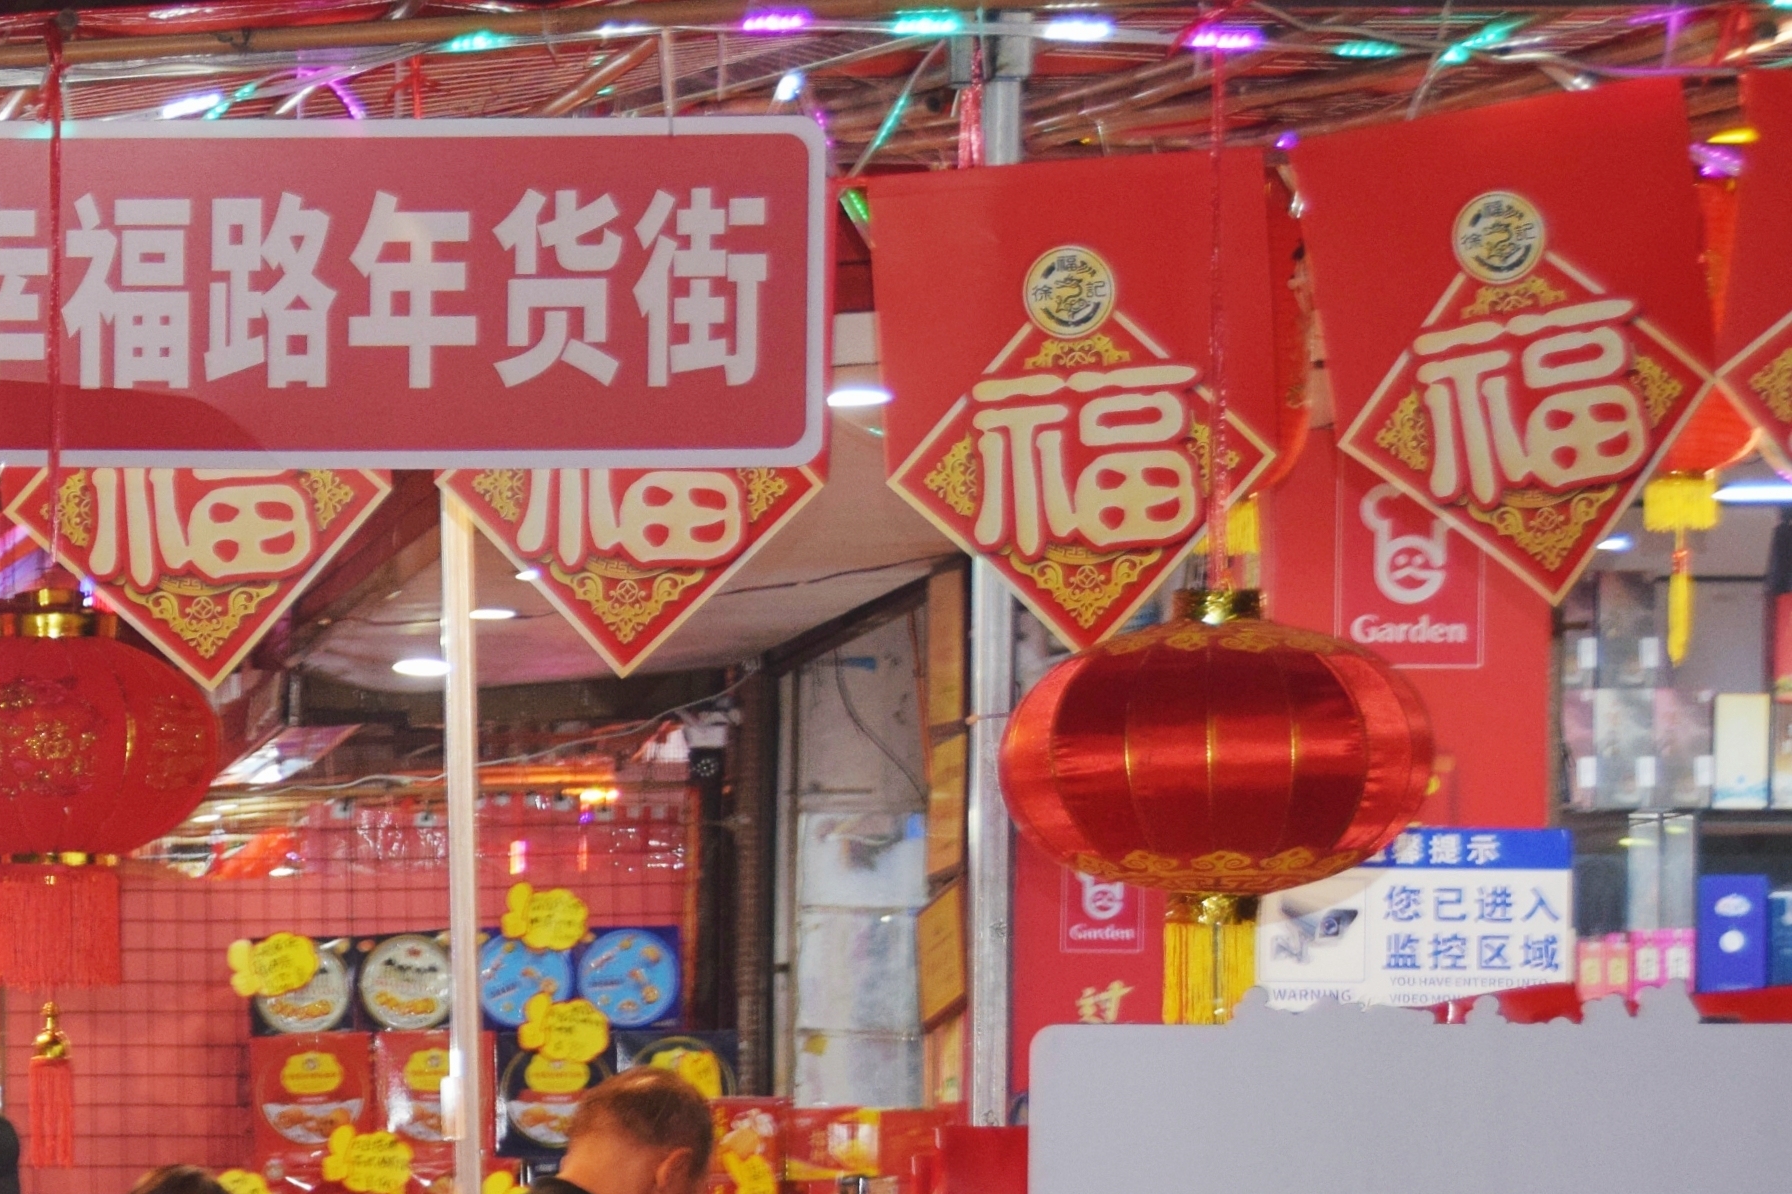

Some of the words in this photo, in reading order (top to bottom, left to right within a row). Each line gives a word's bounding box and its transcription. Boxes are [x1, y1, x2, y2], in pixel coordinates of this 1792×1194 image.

[1414, 298, 1649, 504] 福
[972, 364, 1202, 556] 福
[1350, 613, 1468, 644] Garden
[1362, 832, 1501, 866] 馨提示
[1382, 884, 1561, 923] 您已进入
[1382, 933, 1561, 972] 监控区域
